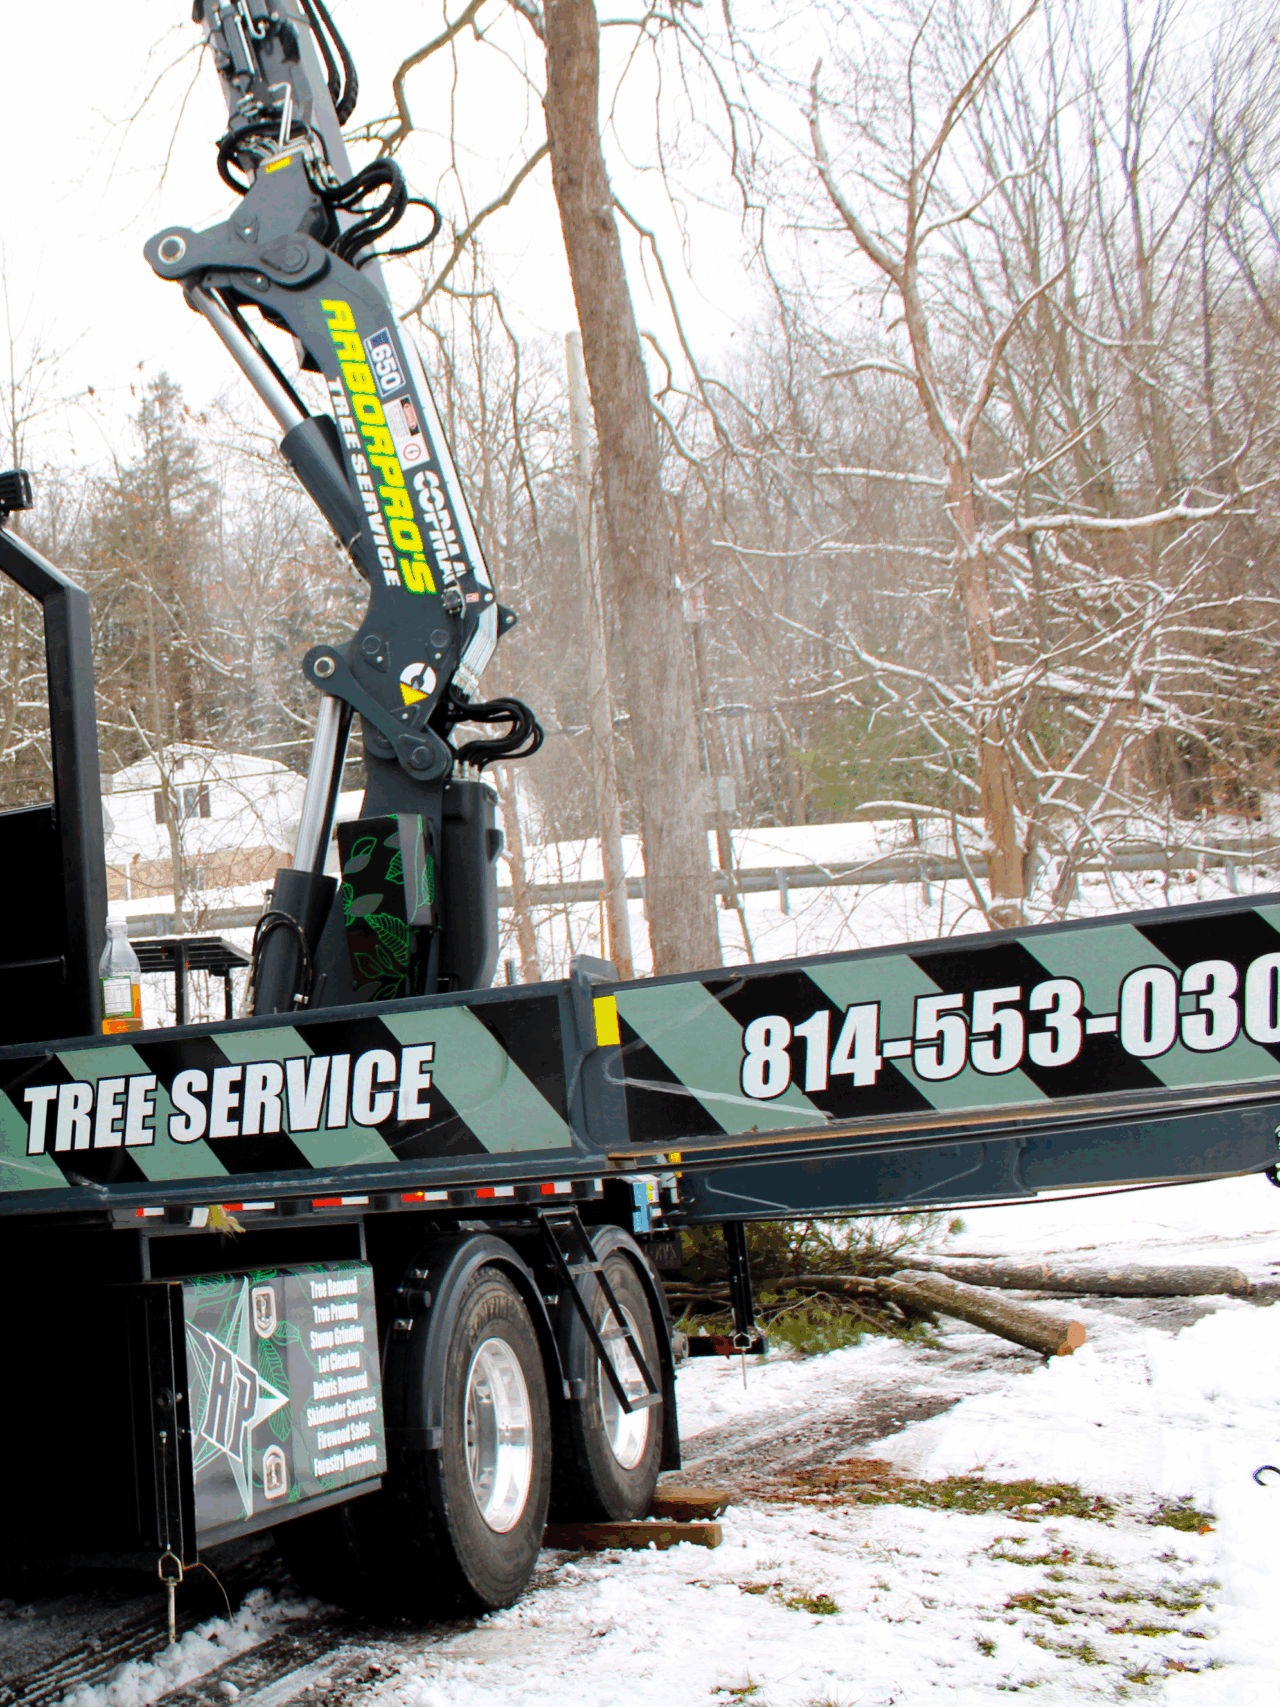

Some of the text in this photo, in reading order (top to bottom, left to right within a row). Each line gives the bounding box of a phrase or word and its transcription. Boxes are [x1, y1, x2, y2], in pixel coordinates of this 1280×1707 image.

[371, 342, 402, 391] 650
[319, 299, 437, 595] ARBORPRO'S
[327, 376, 362, 449] TREE
[350, 453, 402, 587] SERVICE
[413, 470, 467, 584] COPMA
[23, 1042, 436, 1155] TREE SERVICE
[310, 1276, 358, 1299] Tree Removal
[312, 1301, 358, 1324] Tree Pruning
[309, 1324, 364, 1350] Stump Grinding
[318, 1350, 360, 1373] Lot Clearing
[313, 1371, 368, 1400] Debris Removal
[346, 1396, 377, 1416] Services
[317, 1421, 371, 1450] Firewood Sales
[314, 1444, 377, 1477] Forestry Mulching
